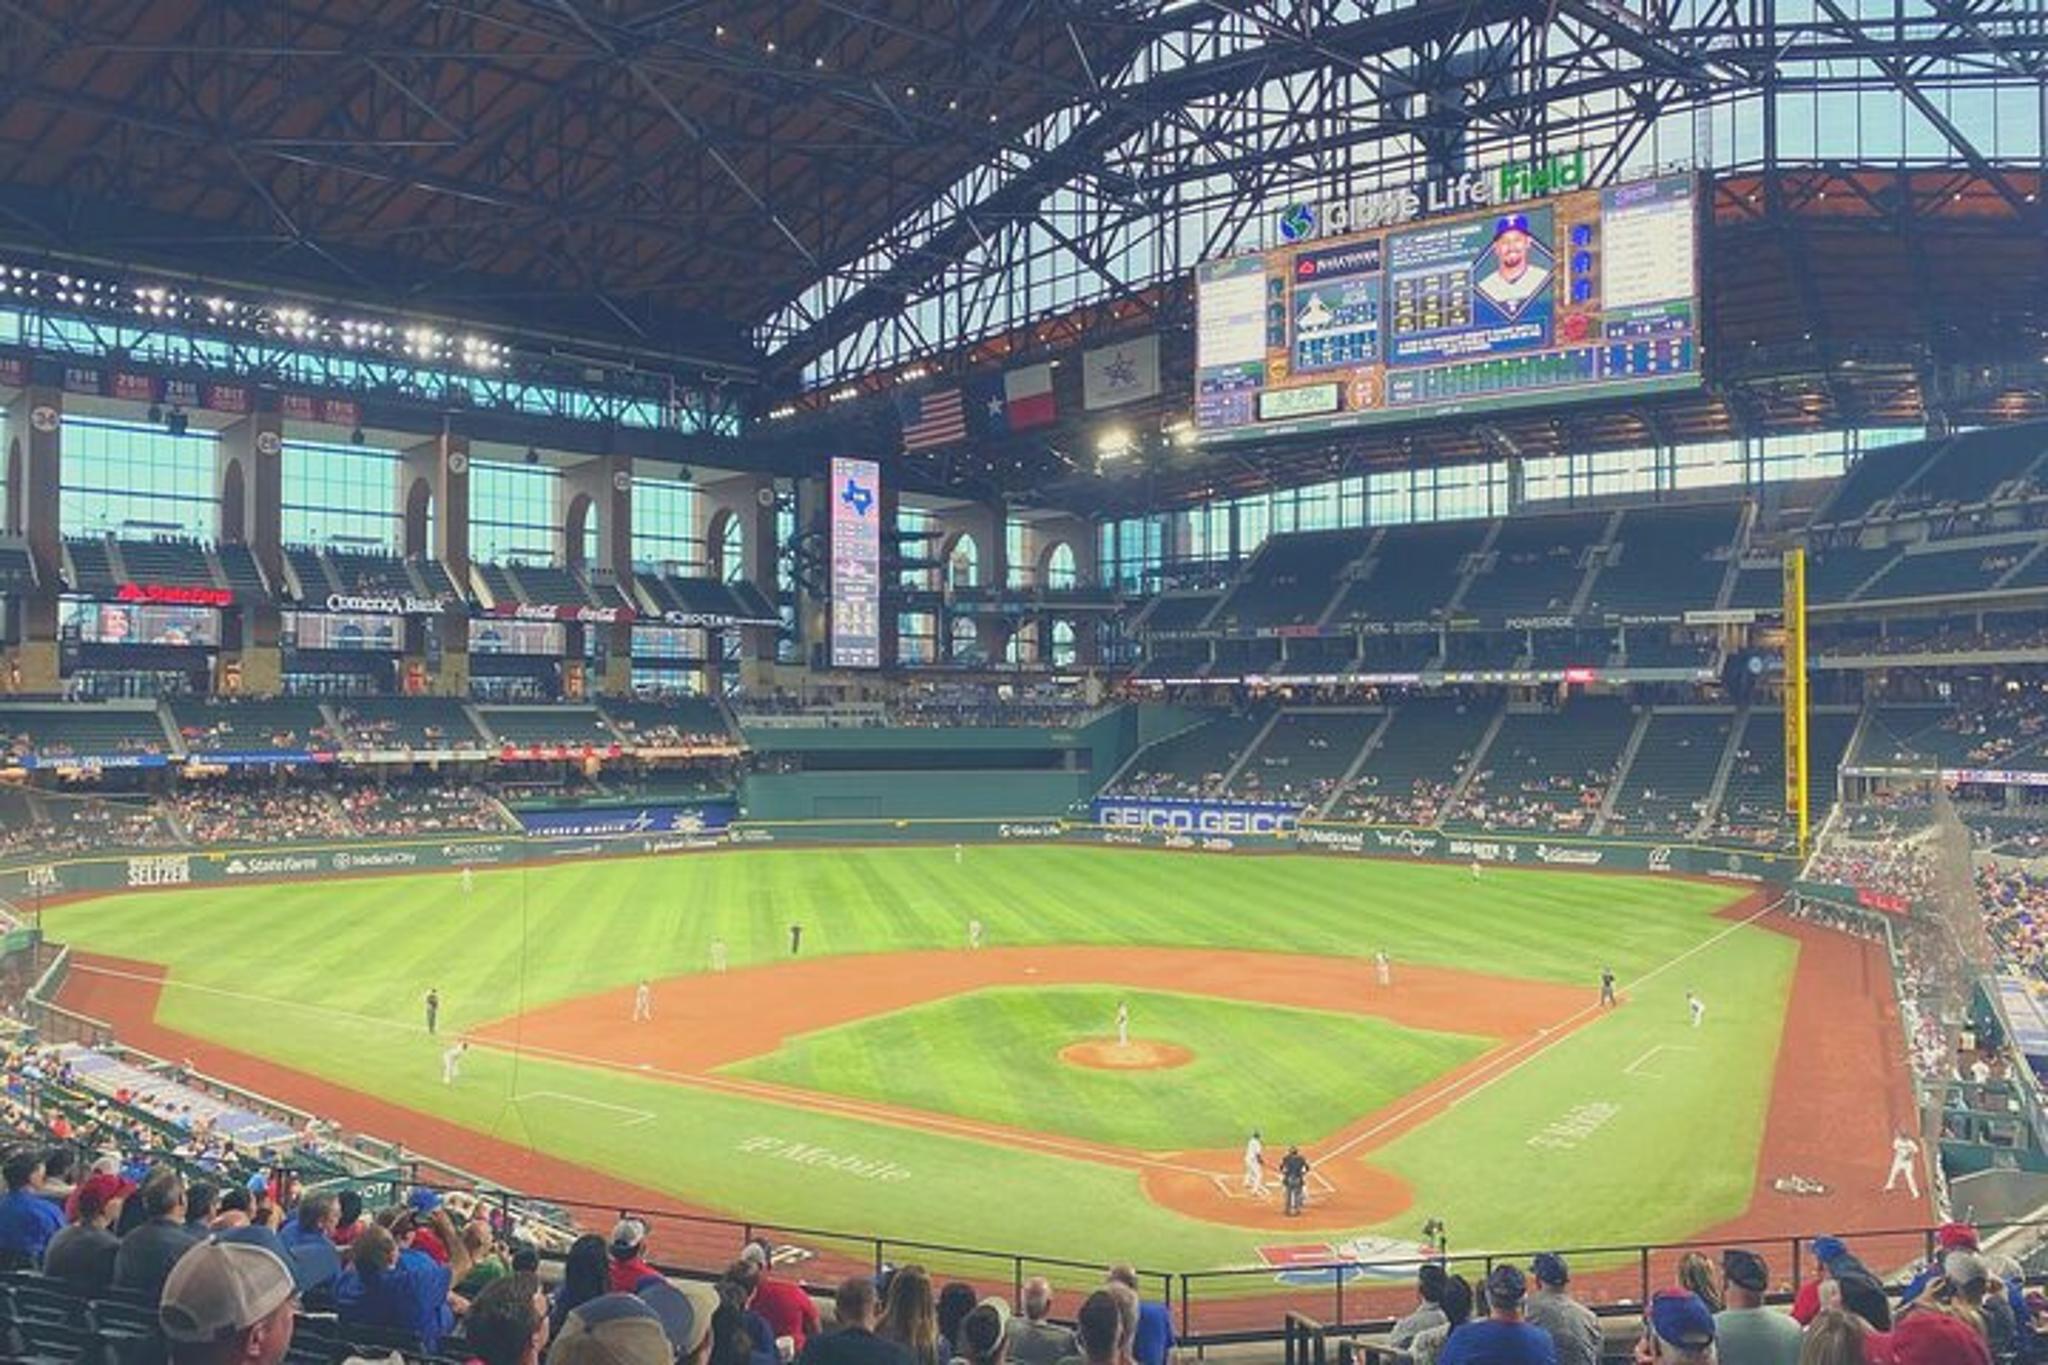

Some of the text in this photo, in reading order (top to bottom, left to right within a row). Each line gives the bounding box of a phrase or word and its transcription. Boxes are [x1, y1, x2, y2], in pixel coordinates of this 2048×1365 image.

[1427, 173, 1493, 212] Life
[1500, 151, 1584, 203] Field
[406, 598, 445, 613] Bank
[1100, 807, 1299, 834] GEICO GEICO
[127, 863, 190, 887] SELTZER
